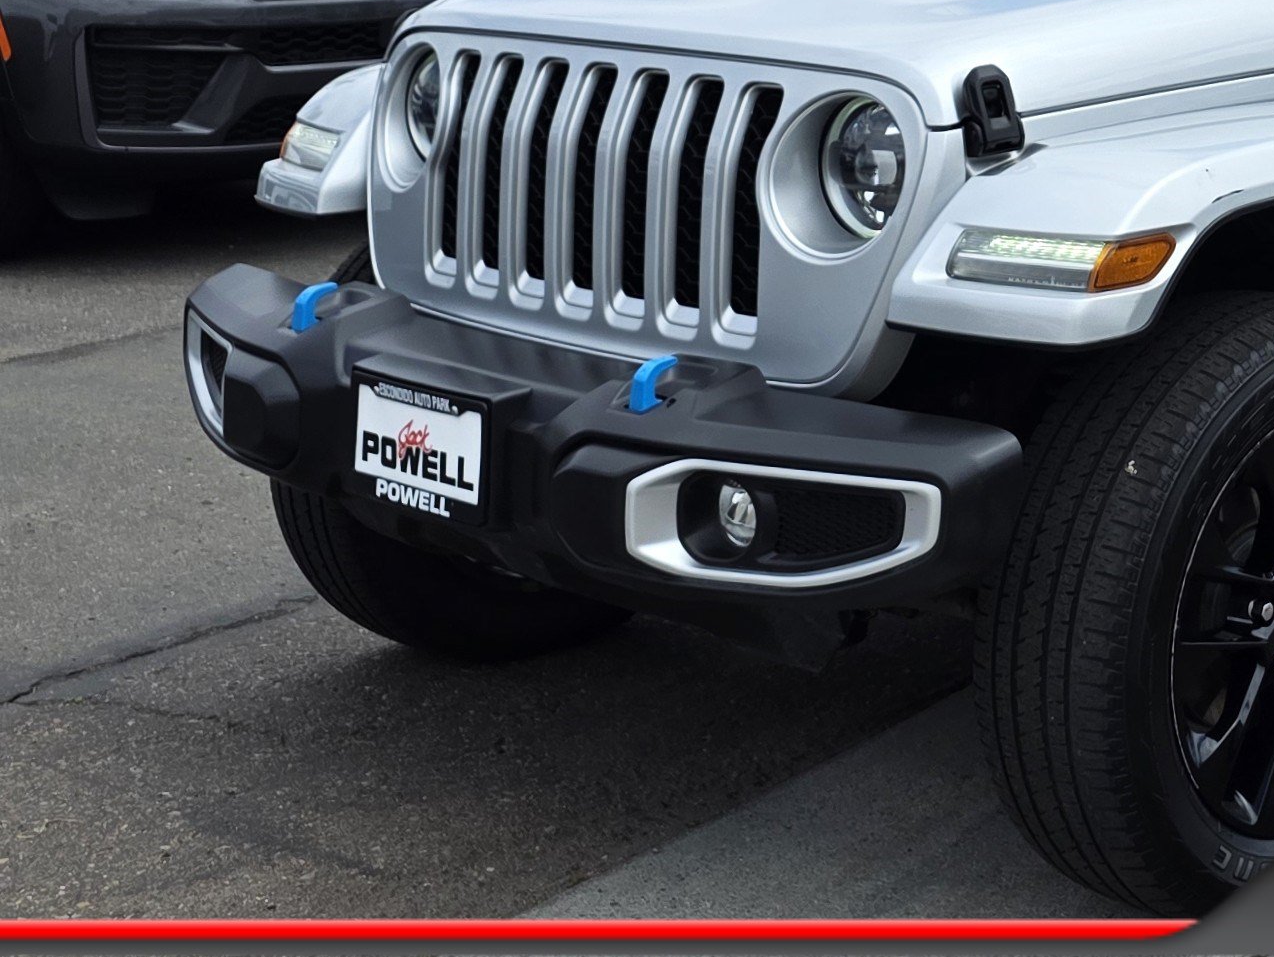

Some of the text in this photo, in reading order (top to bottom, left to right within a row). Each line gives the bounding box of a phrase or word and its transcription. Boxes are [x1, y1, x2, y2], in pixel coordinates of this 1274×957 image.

[378, 382, 450, 411] ESCONDIDO AUTO PARK
[398, 419, 433, 460] Jack
[361, 430, 474, 492] POWELL
[375, 478, 450, 518] POWELL
